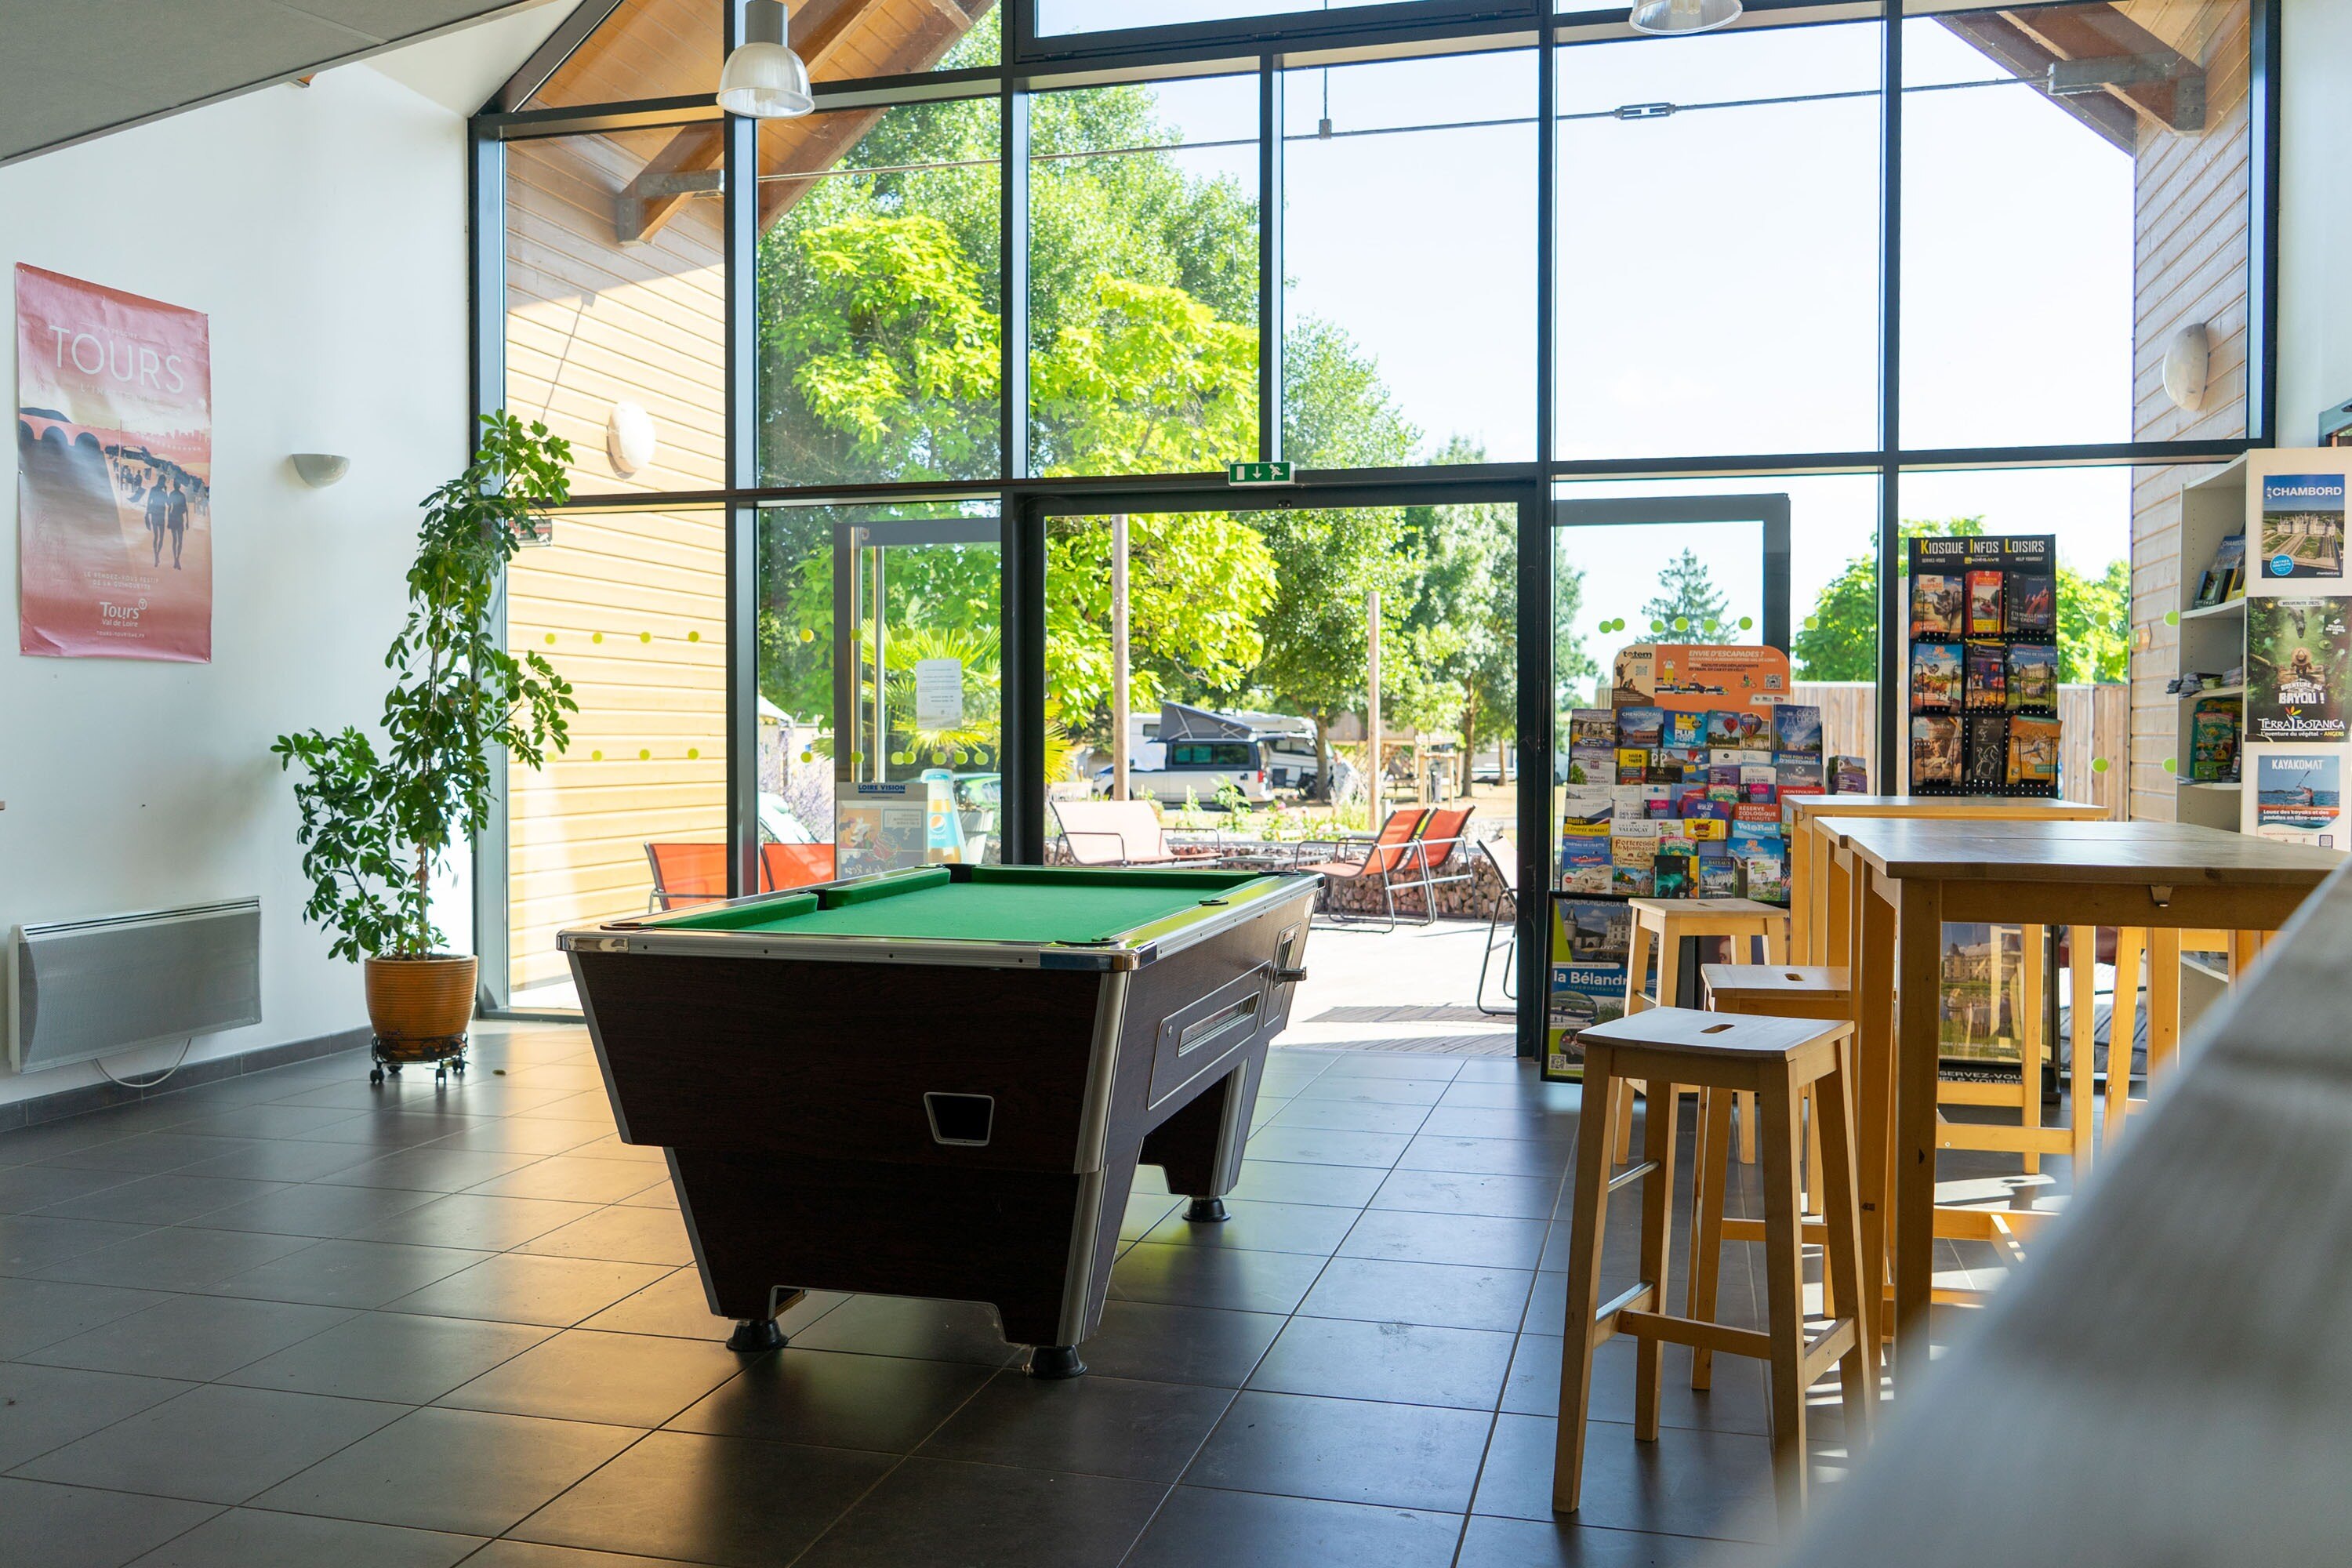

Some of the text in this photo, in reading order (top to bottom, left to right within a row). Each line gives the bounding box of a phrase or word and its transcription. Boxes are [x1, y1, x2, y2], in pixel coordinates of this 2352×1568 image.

[49, 325, 184, 394] TOURS
[2272, 486, 2342, 496] CHAMBORD
[100, 601, 140, 619] Tours
[2278, 692, 2325, 704] BAYOU !
[2257, 717, 2345, 730] TERRA BOTANICA
[2272, 759, 2325, 770] KAYAKOMAT
[1615, 839, 1655, 848] Forteresse
[1554, 970, 1566, 983] la
[1939, 1070, 2023, 1080] SERVEZ-VOU
